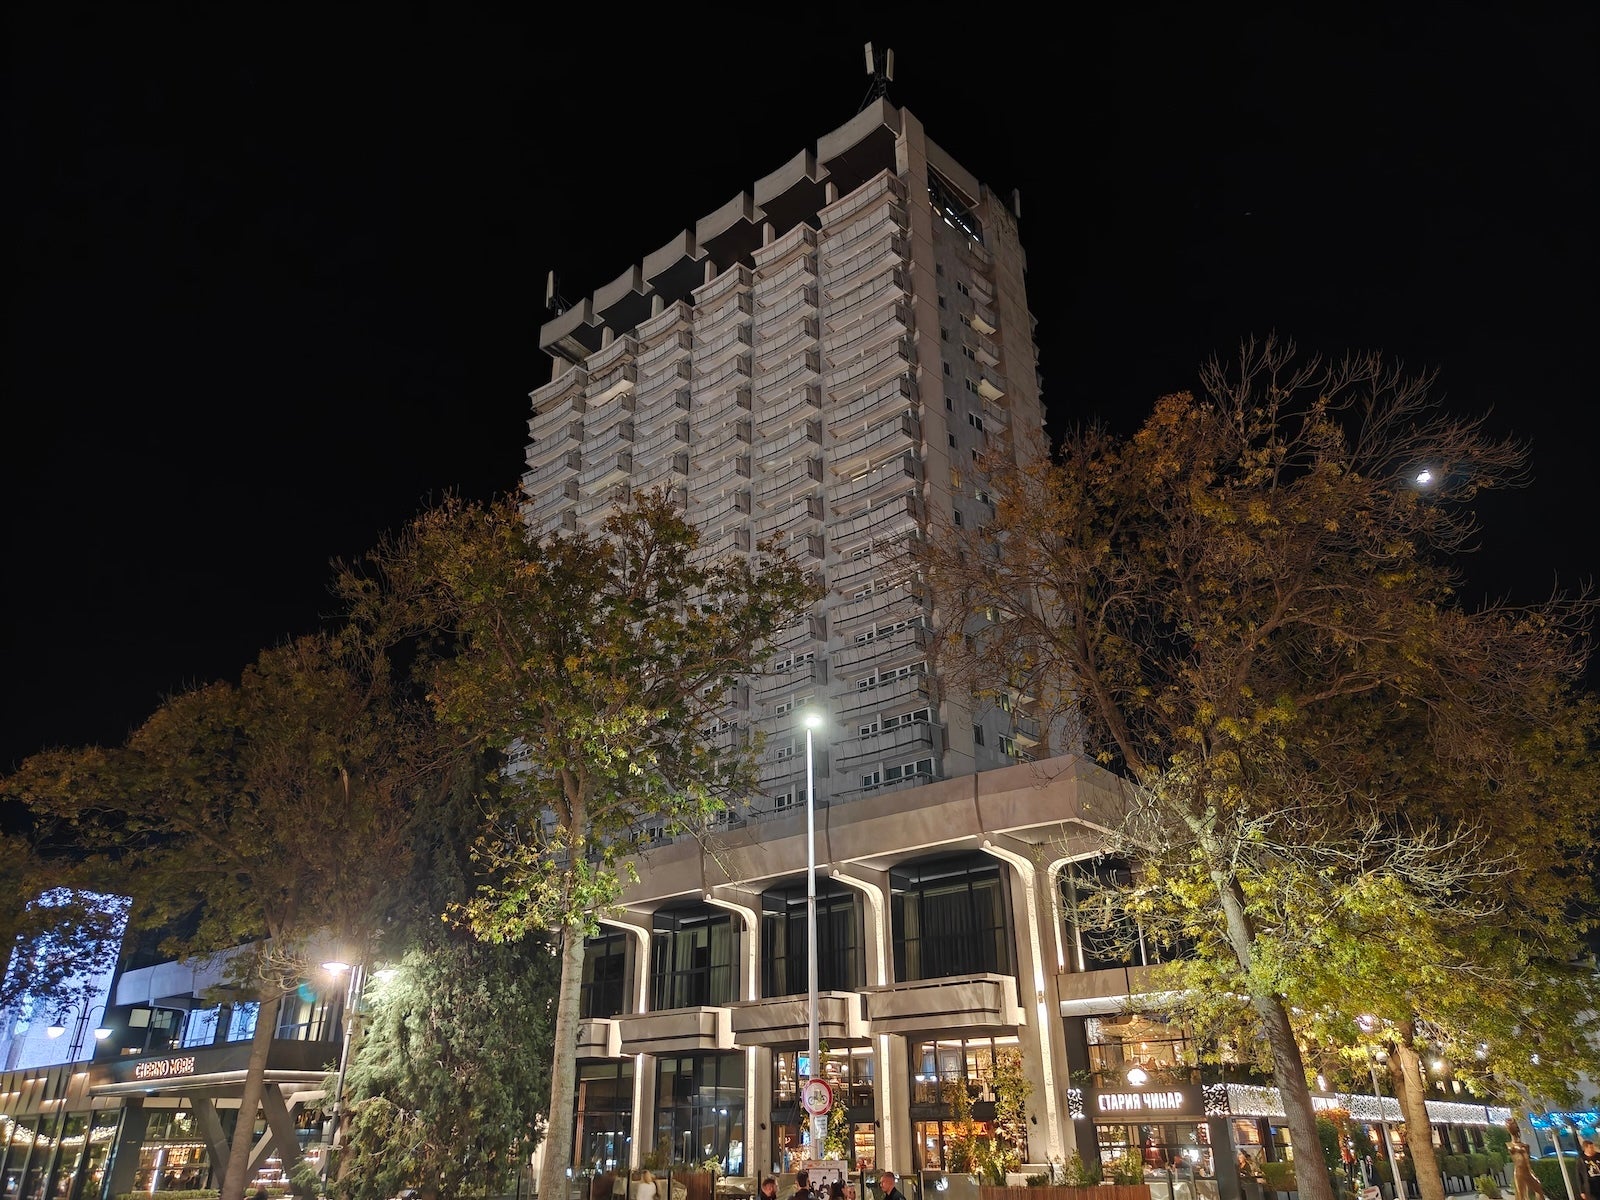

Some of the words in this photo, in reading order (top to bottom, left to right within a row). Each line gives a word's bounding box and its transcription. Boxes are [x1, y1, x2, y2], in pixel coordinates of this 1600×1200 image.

[136, 1060, 169, 1078] CHERNO
[1098, 1094, 1141, 1110] СТАРИЯ
[1143, 1092, 1183, 1109] ЧИНАР
